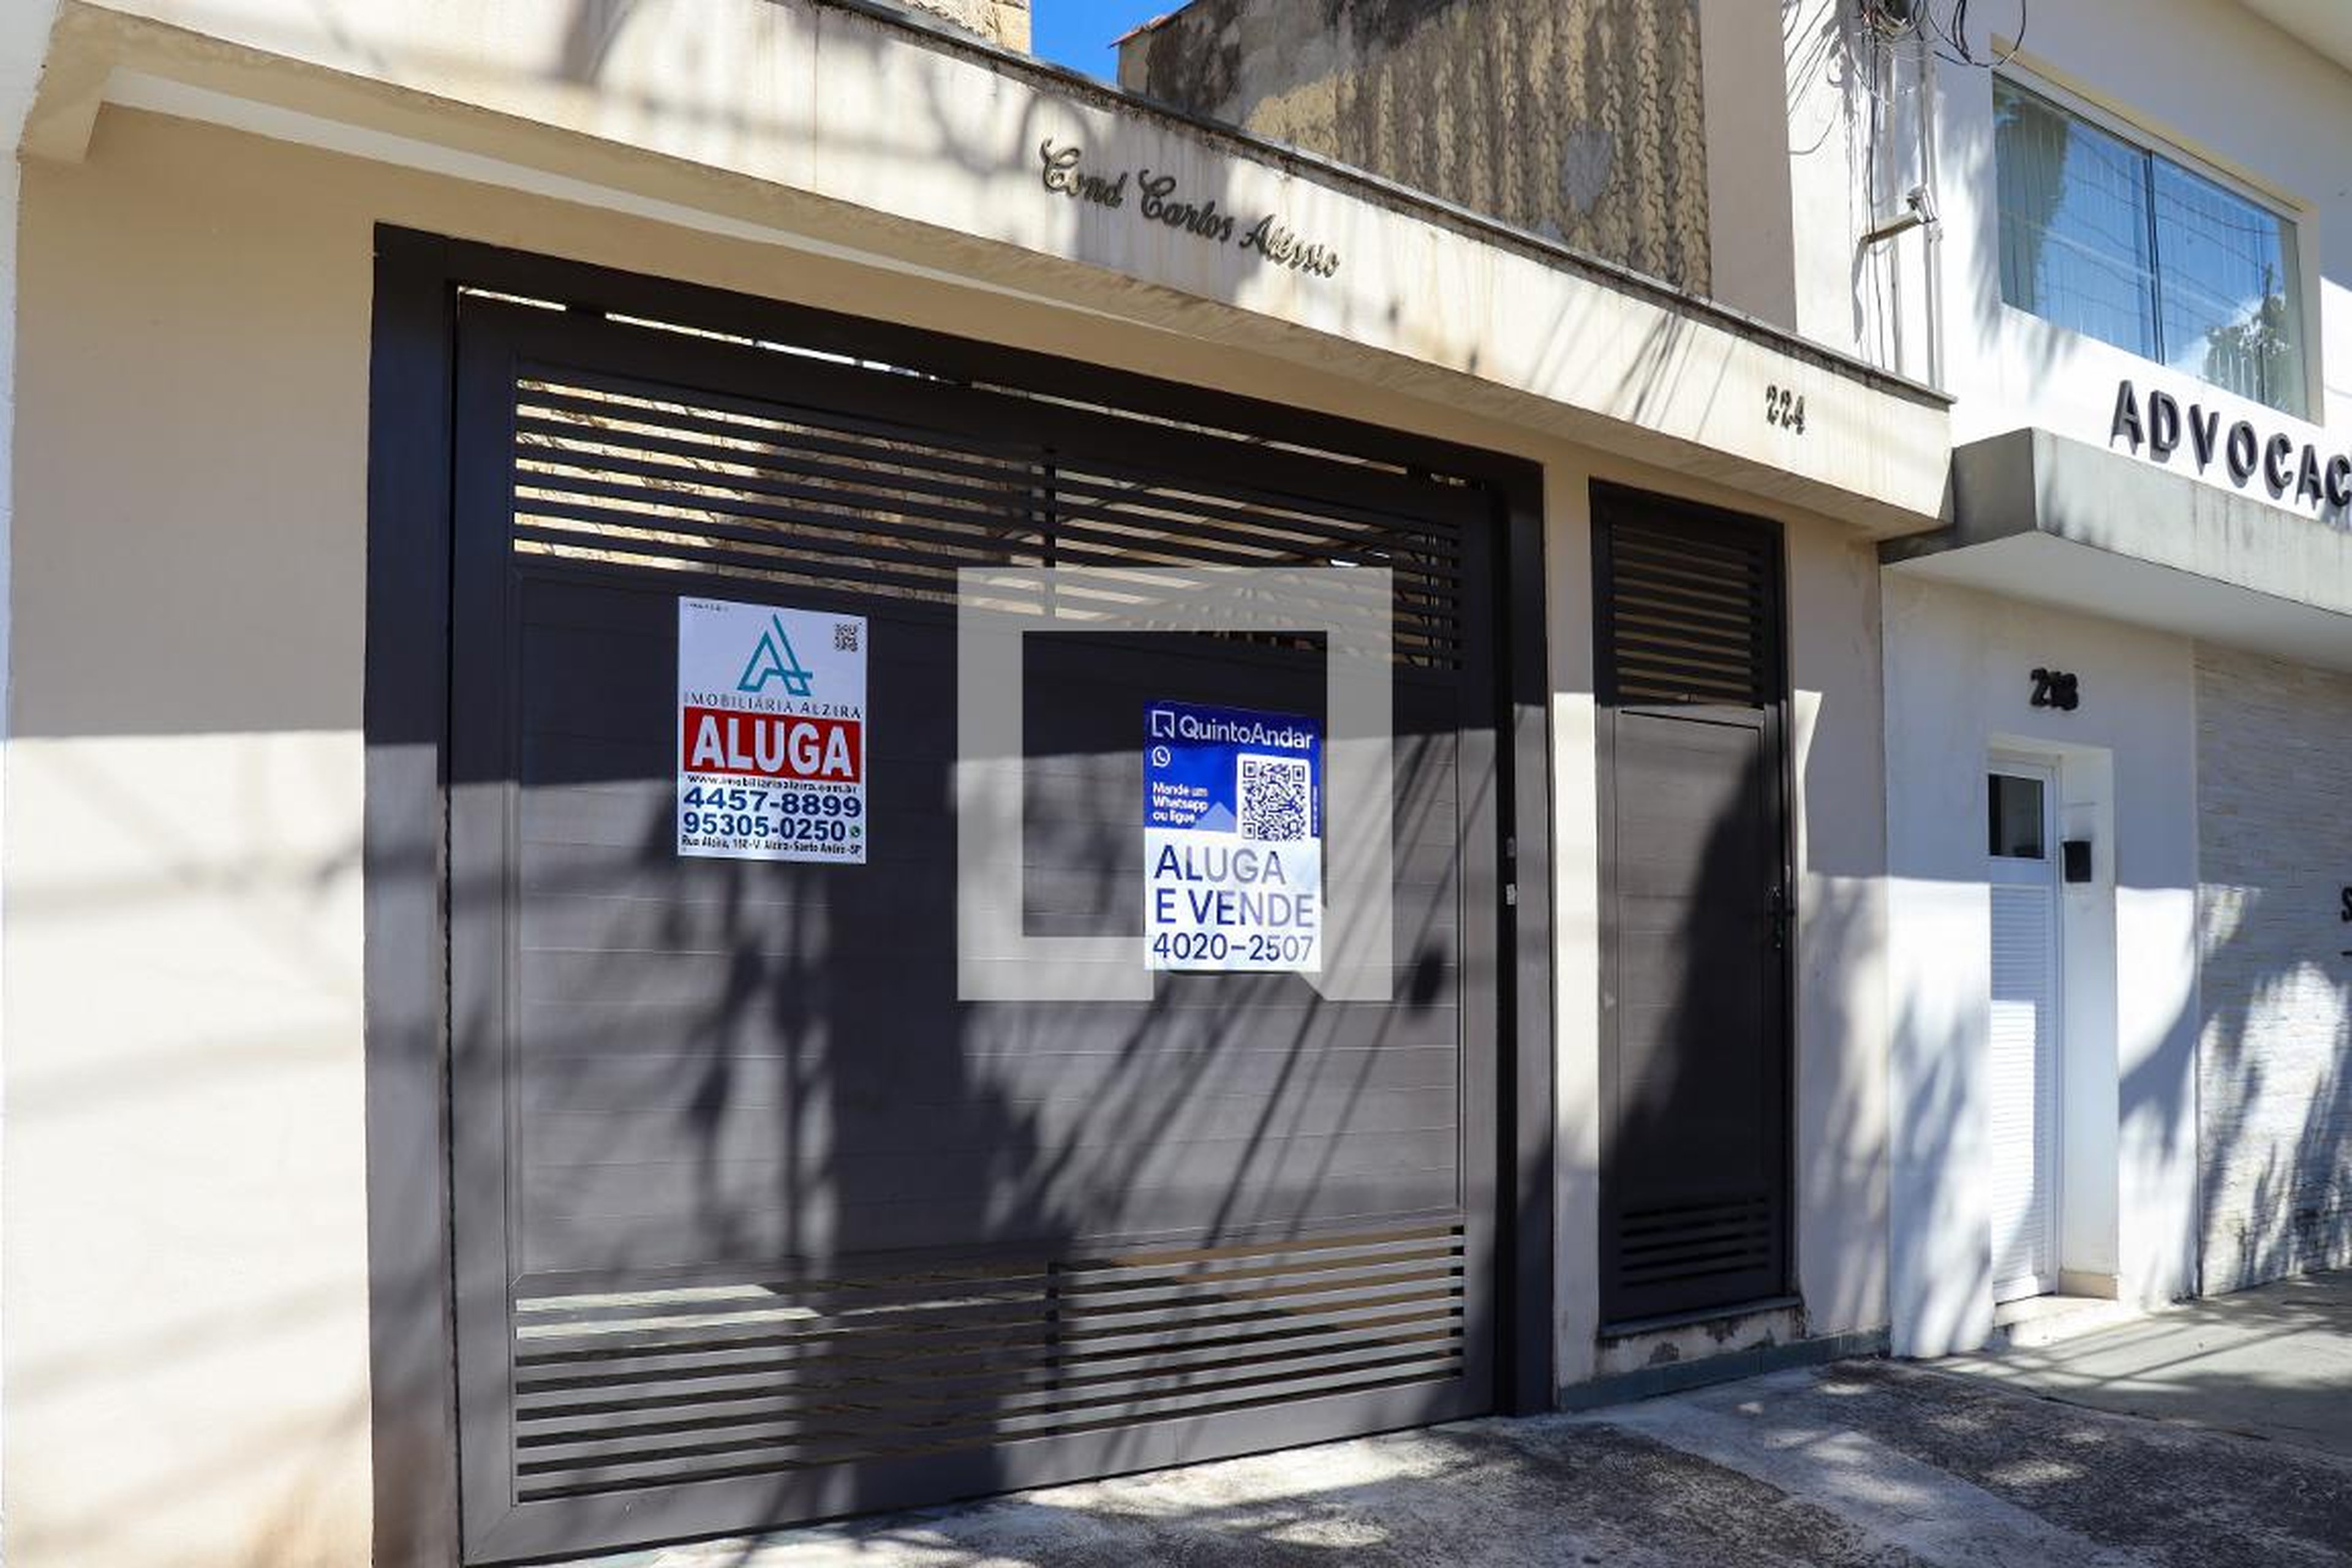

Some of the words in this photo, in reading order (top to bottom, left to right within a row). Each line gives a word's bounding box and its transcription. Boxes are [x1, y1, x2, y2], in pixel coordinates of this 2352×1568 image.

[1139, 169, 1235, 241] Carlos
[1765, 384, 1805, 435] 224
[2111, 380, 2351, 507] ADVOCAC
[2030, 668, 2079, 711] 218
[800, 703, 861, 718] ALZIRA
[692, 714, 853, 777] ALUGA
[1179, 715, 1314, 749] QuintoAndar
[684, 786, 862, 818] 4457-8899
[1153, 782, 1189, 796] Mande
[684, 812, 846, 842] 95305-0250
[1153, 812, 1167, 821] ou
[1170, 810, 1196, 824] ligue
[682, 834, 699, 846] Rua
[1153, 845, 1286, 884] ALUGA
[1156, 889, 1177, 924] E
[1188, 889, 1314, 927] VENDE
[1153, 933, 1314, 962] 4020-2507
